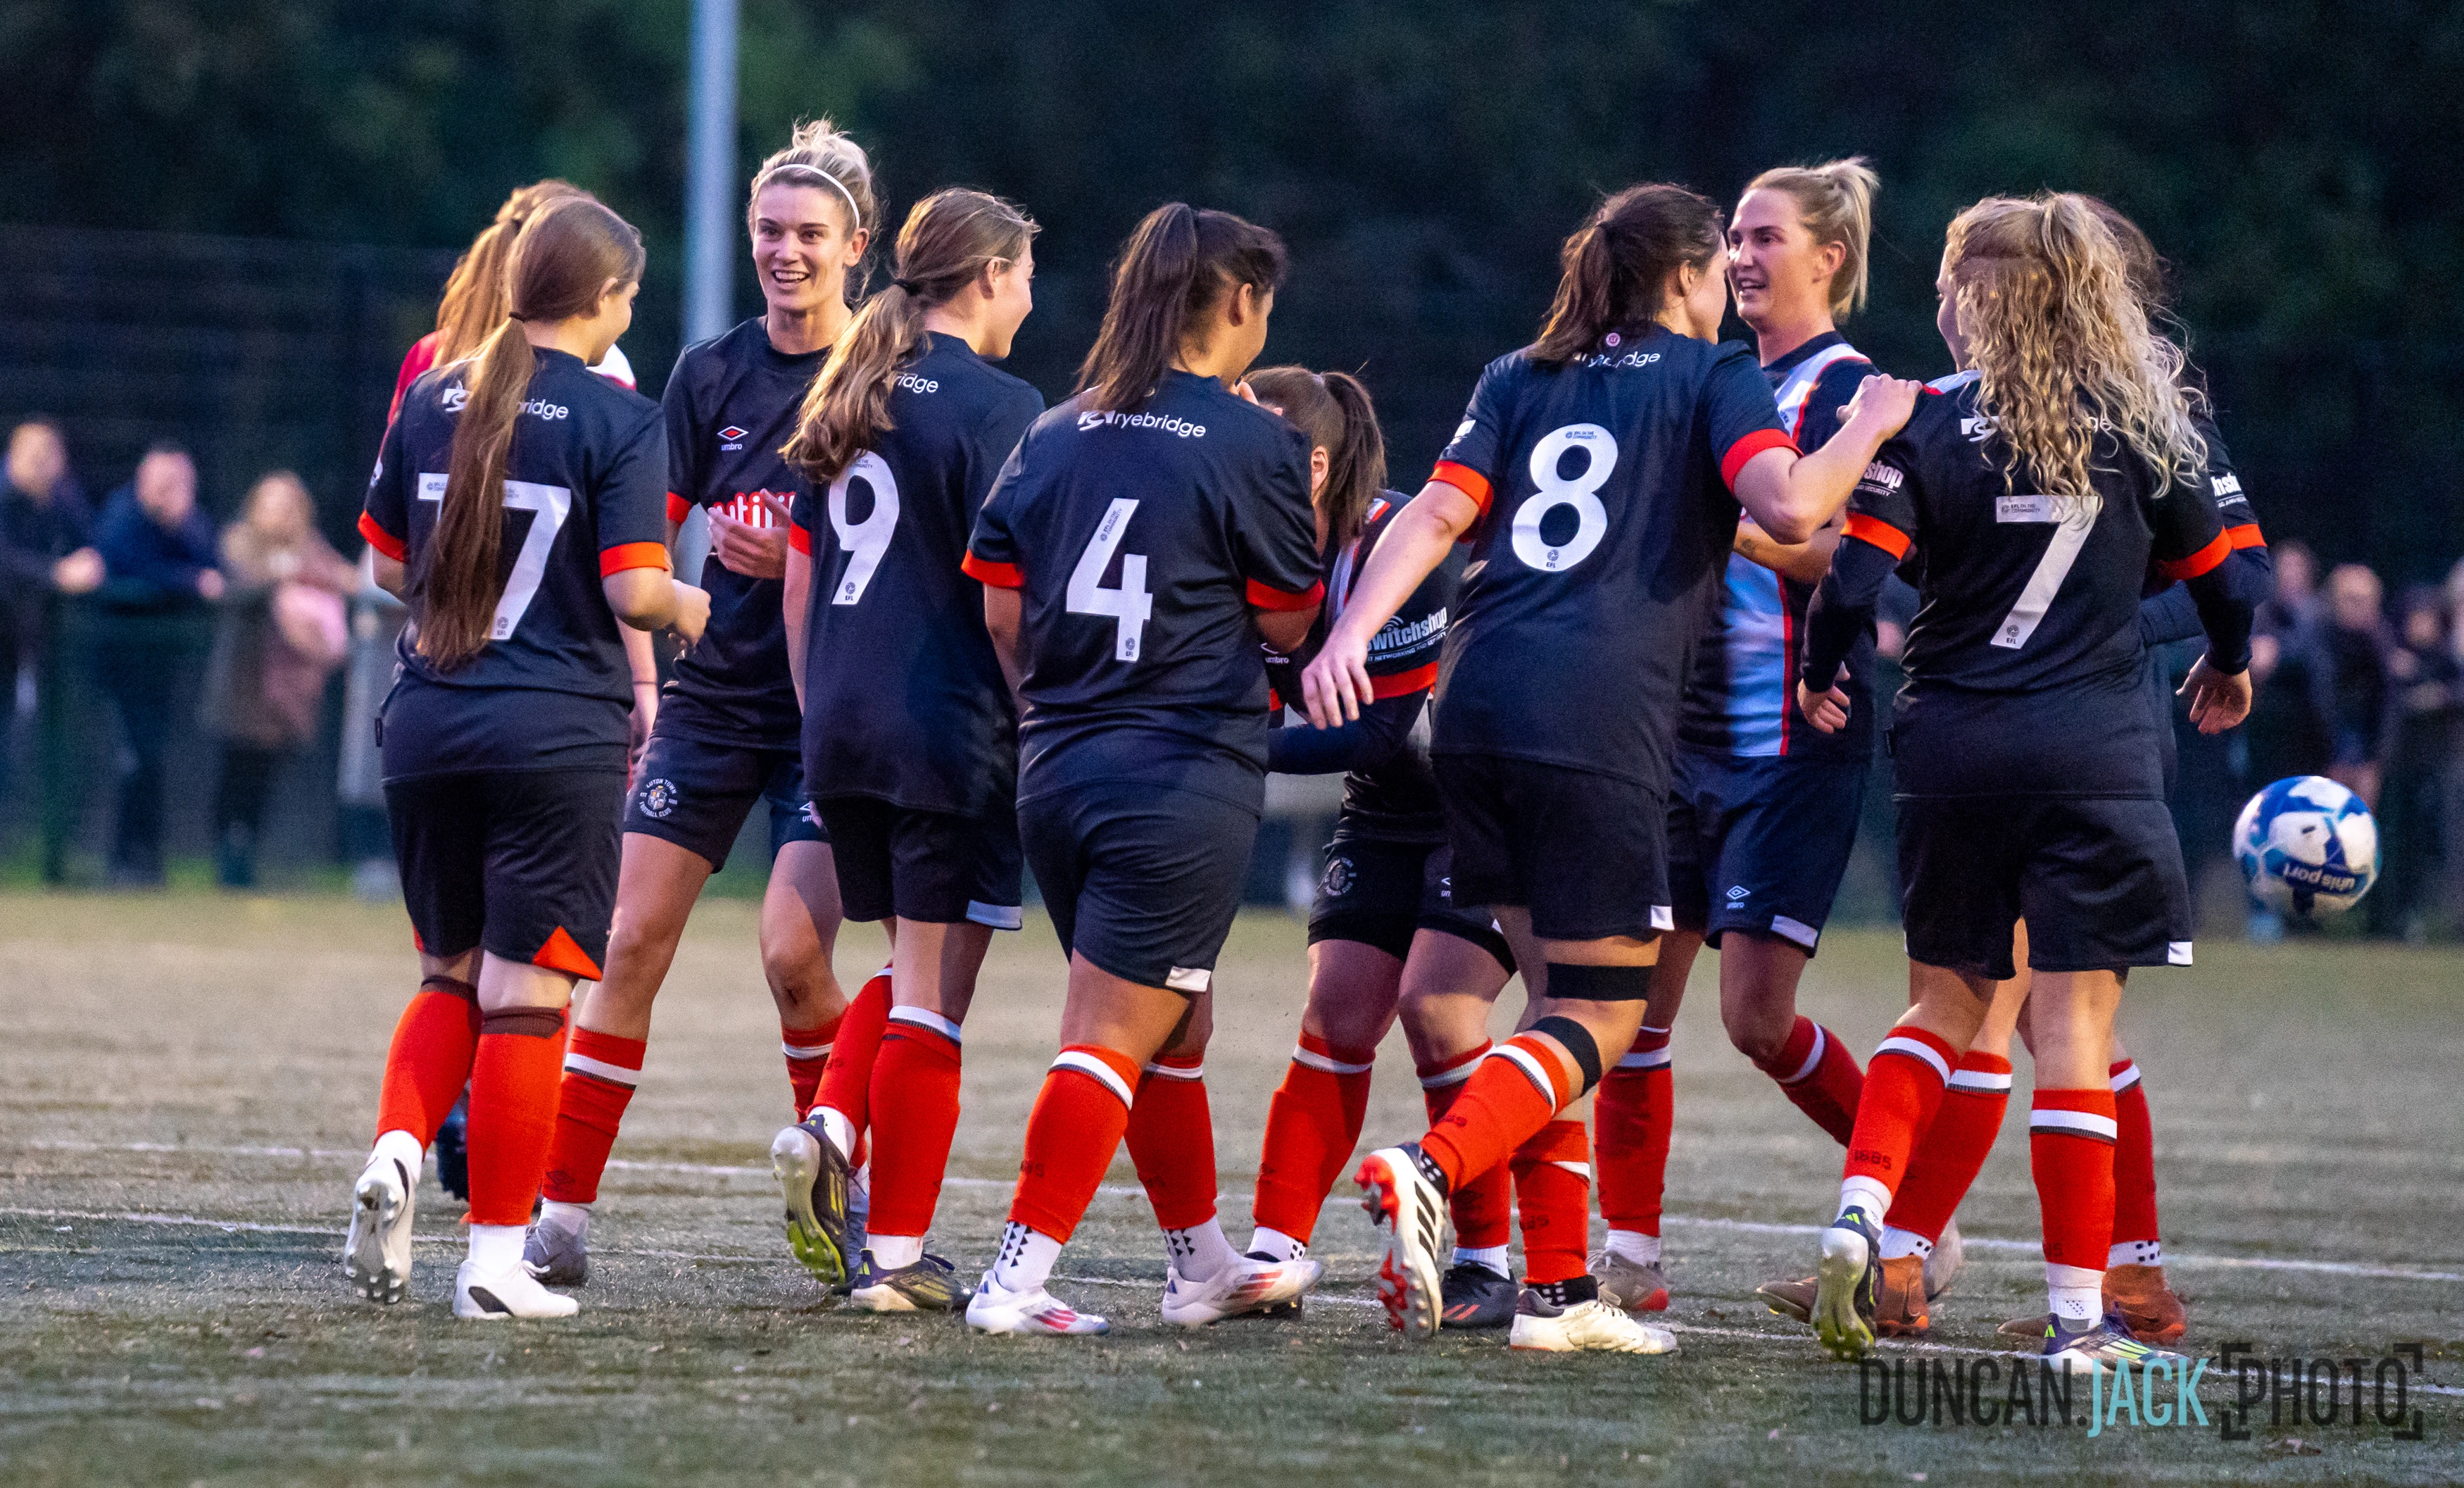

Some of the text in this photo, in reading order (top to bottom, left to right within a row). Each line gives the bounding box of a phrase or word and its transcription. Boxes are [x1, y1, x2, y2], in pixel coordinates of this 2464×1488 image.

[721, 442, 743, 451] umbro
[1114, 411, 1207, 437] ryebridge
[827, 449, 900, 605] 9
[1511, 423, 1618, 572] 8
[1066, 497, 1153, 663] 4
[1990, 494, 2104, 649] 7
[1374, 647, 1416, 661] NETWORKING
[646, 778, 677, 794] LUTON TOWN
